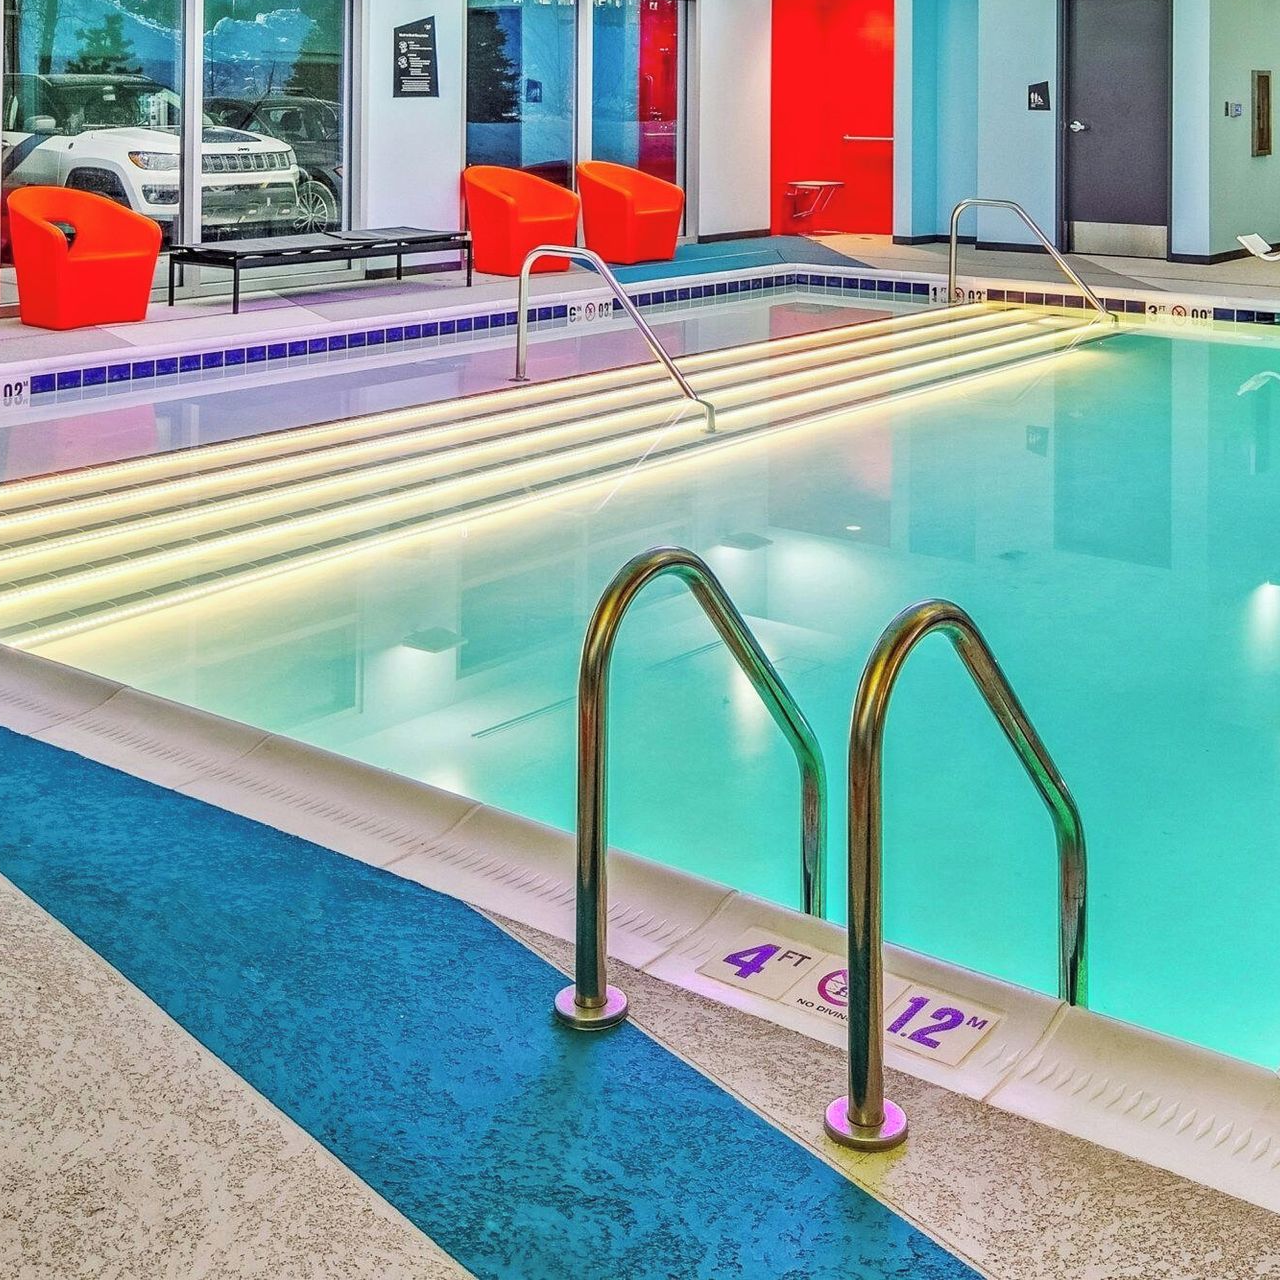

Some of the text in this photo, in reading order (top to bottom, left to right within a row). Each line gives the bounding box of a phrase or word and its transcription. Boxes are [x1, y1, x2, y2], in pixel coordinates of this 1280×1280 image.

[723, 943, 812, 979] 4 FT
[796, 998, 814, 1008] NO
[886, 996, 989, 1049] 1.2 M
